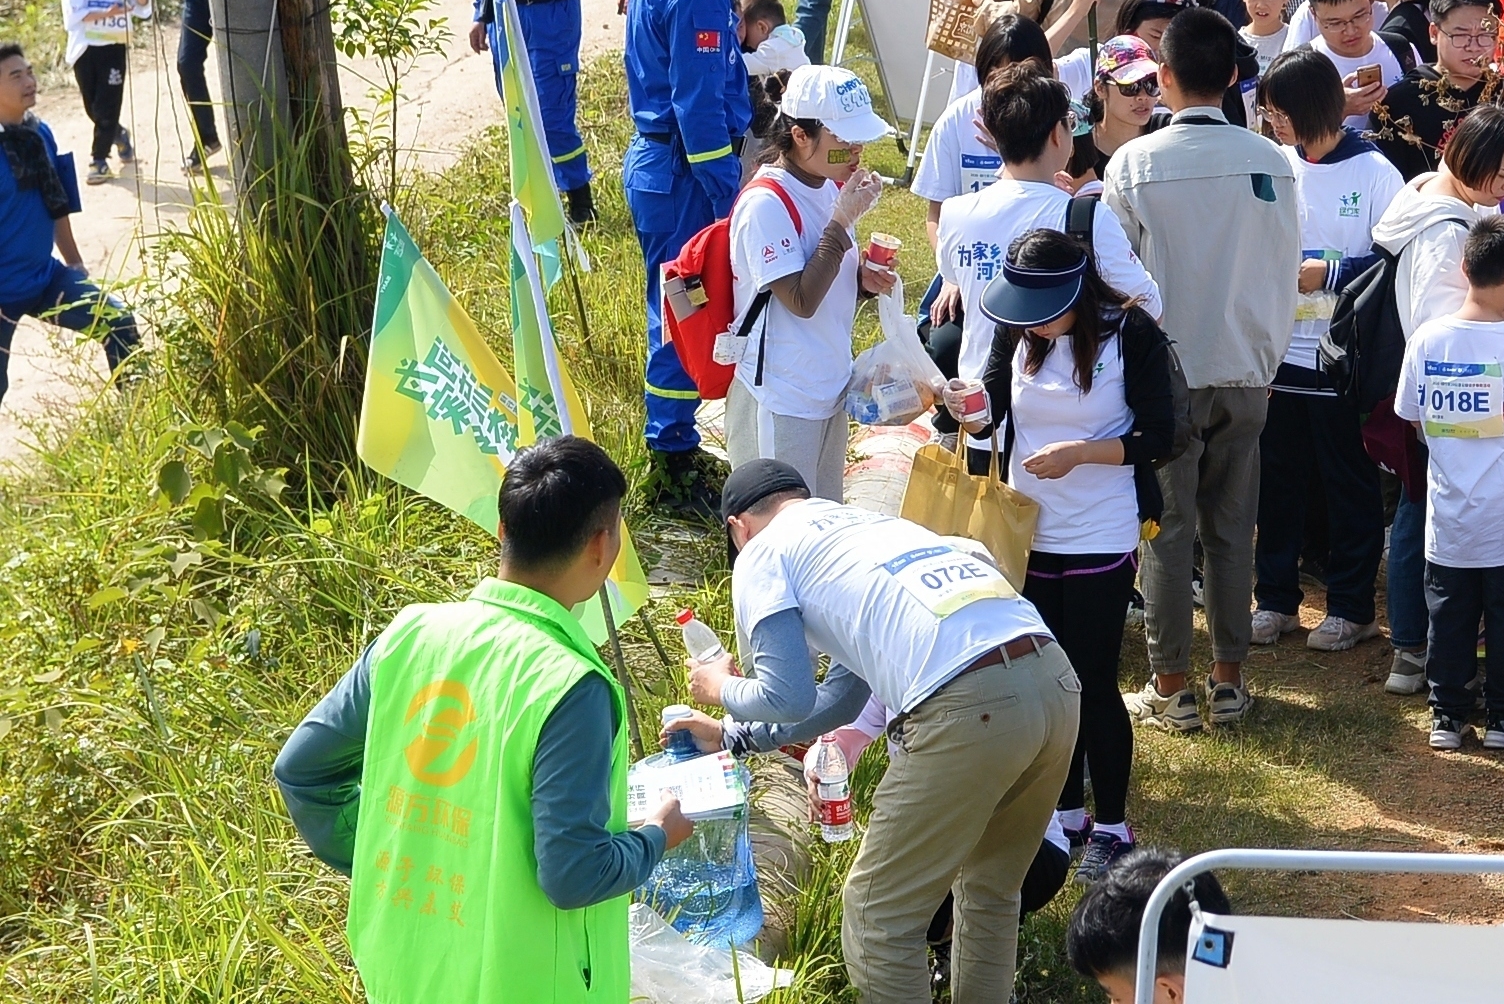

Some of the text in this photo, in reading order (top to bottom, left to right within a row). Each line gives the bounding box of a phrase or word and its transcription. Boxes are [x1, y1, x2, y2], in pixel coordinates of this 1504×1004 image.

[957, 241, 1002, 267] 为家乡
[1431, 390, 1490, 413] 018E
[920, 562, 988, 590] 072E
[385, 784, 473, 838] 源方环保
